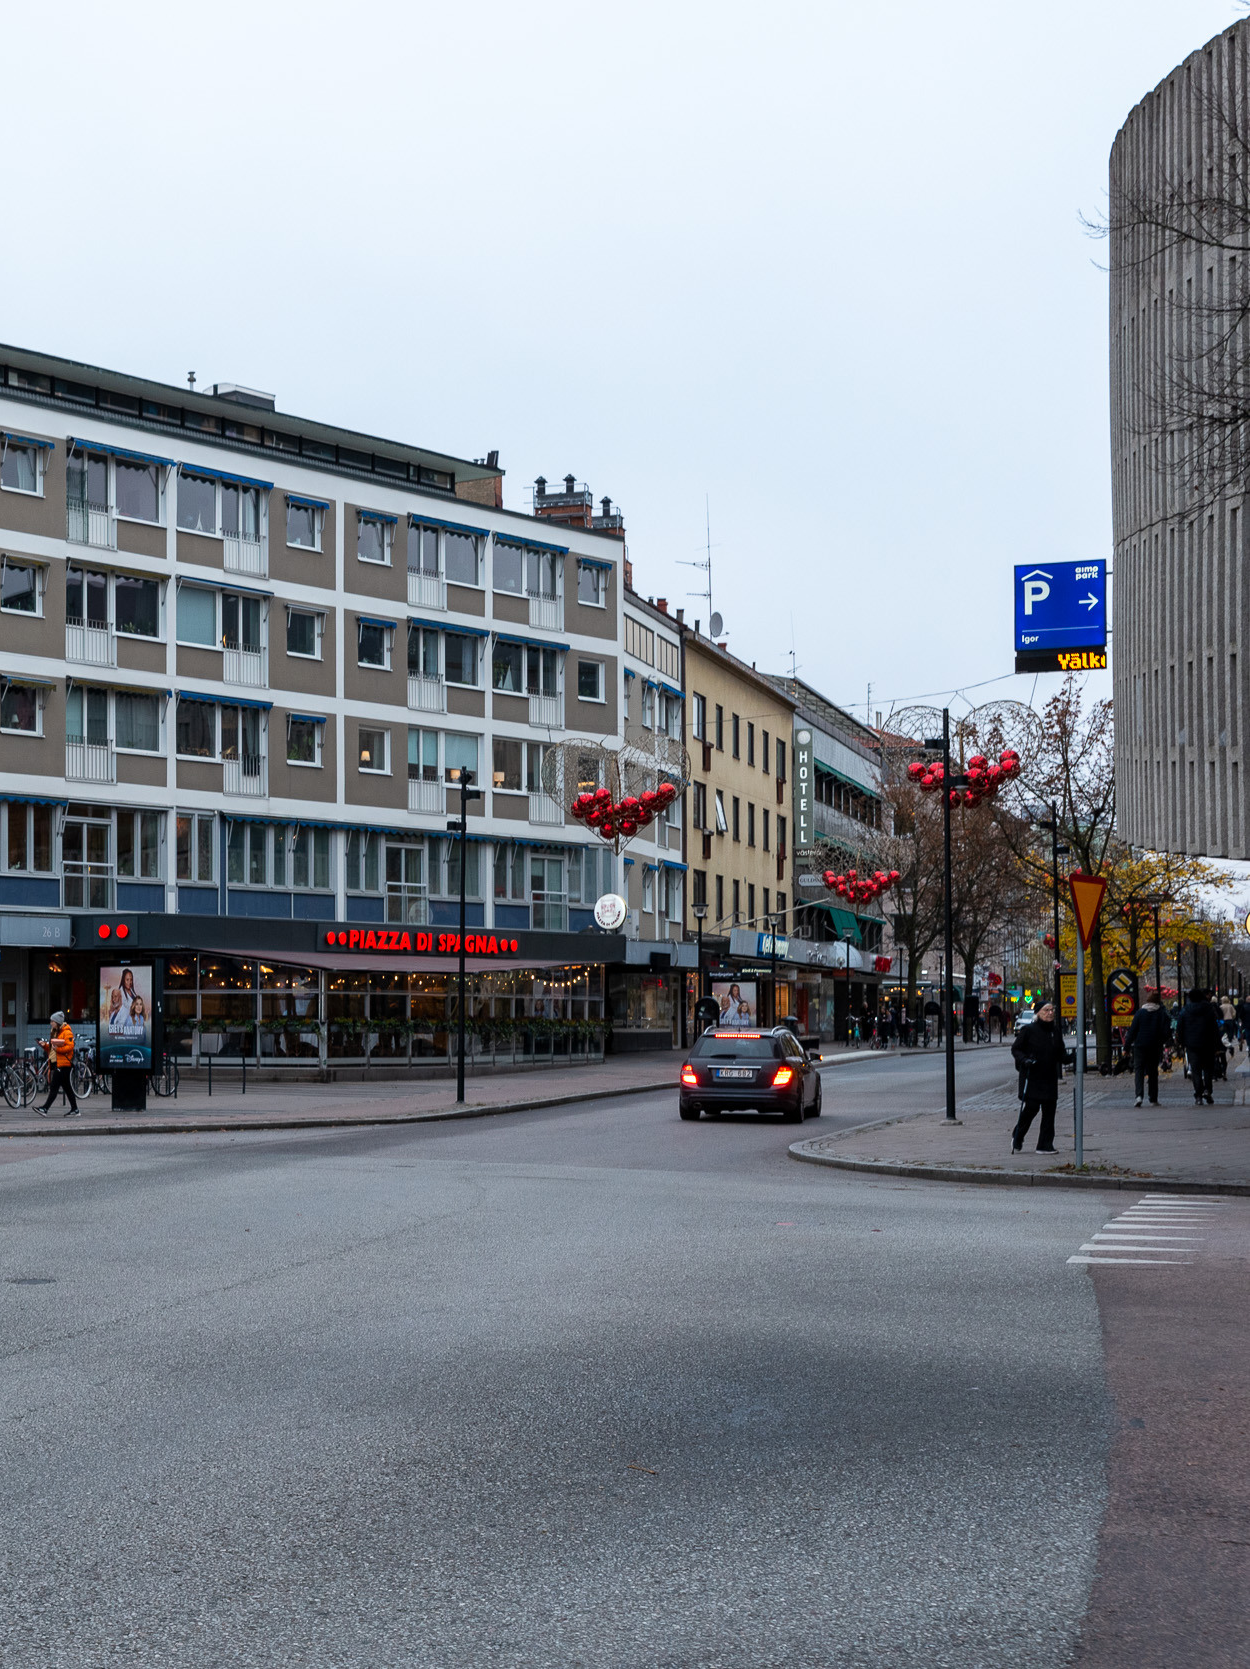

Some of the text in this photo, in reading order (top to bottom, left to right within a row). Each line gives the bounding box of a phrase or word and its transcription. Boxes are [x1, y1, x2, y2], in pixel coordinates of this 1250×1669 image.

[1075, 572, 1099, 581] park
[1024, 580, 1051, 615] P
[1021, 634, 1040, 645] Igor
[799, 751, 808, 843] HOTELL
[42, 926, 61, 938] 26 B
[349, 929, 499, 954] PIAZZA DI SPAGNA
